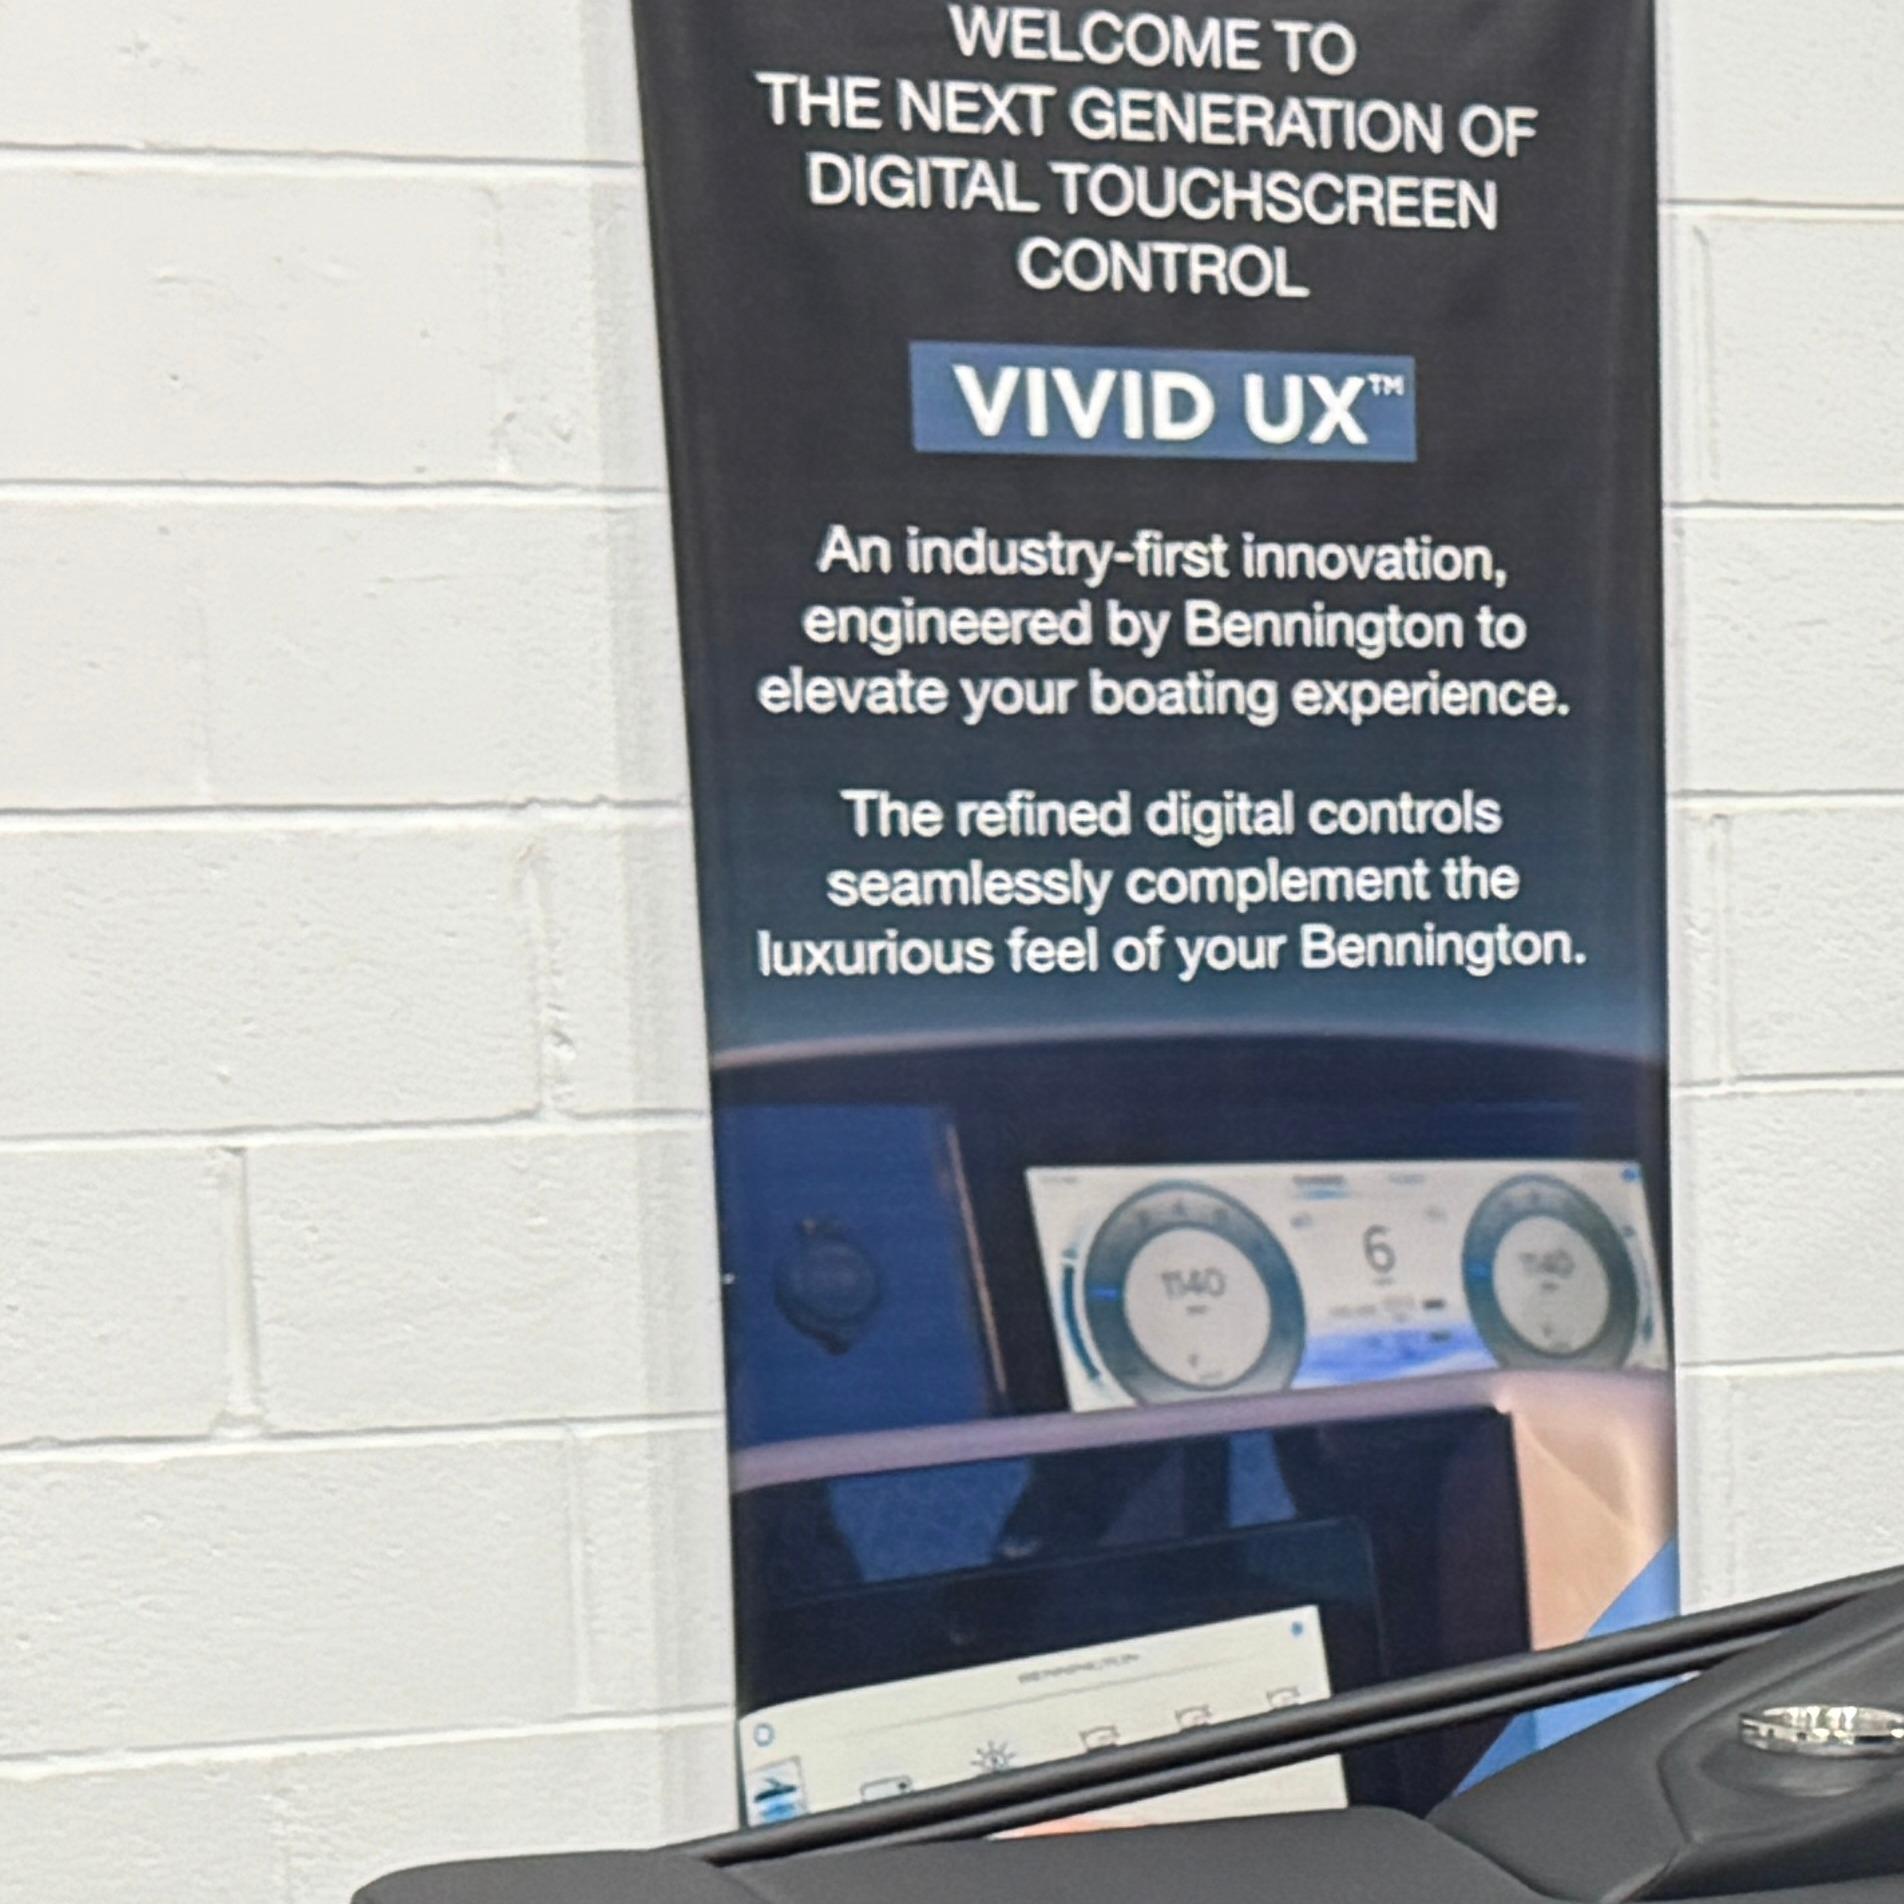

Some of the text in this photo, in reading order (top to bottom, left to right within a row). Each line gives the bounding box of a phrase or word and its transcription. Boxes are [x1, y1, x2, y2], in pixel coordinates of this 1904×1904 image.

[949, 5, 1356, 75] WELCOME TO
[756, 72, 1538, 157] THE NEXT GENERATION OF
[807, 152, 1497, 230] DIGITAL TOUCHSCREEN
[1018, 236, 1310, 297] CONTROL
[954, 365, 1214, 440] VIVID
[817, 525, 1506, 588] An industry-first innovation,
[803, 597, 1526, 659] engineered by Bennington to
[758, 666, 1569, 727] elevate your boating experience.
[840, 789, 1502, 847] The refined digital controls
[827, 856, 1520, 915] seamlessly complement the
[758, 922, 1586, 982] luxurious feel of your Bennington.
[1363, 1224, 1396, 1273] 6
